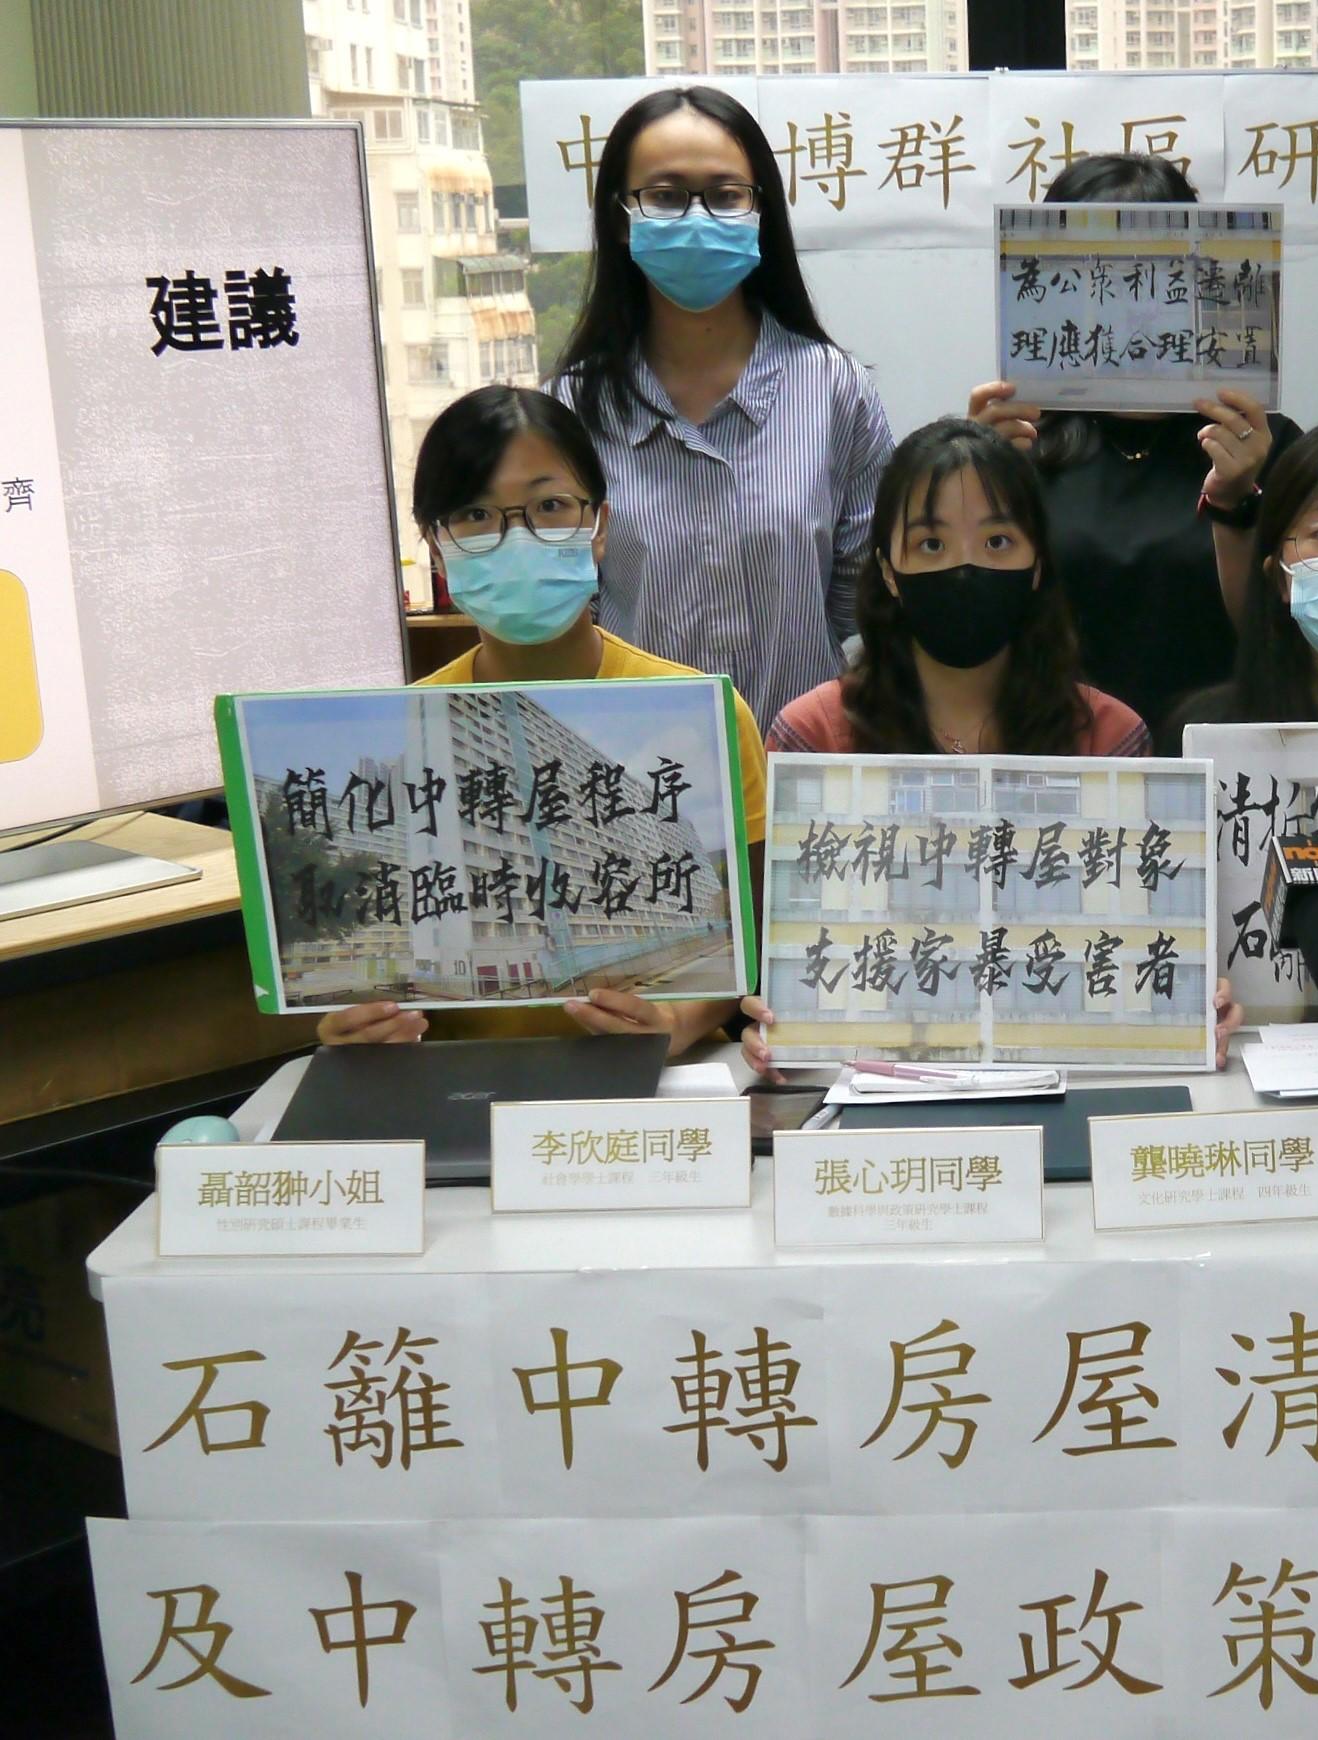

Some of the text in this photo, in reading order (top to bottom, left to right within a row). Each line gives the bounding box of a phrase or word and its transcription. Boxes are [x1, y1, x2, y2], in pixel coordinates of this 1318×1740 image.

[144, 266, 301, 357] 建議
[1011, 319, 1262, 371] 理應獲合理安置
[1, 477, 35, 513] 齊
[281, 756, 694, 841] 簡化中轉屋程序
[797, 818, 1186, 891] 檢視中轉屋對象
[798, 927, 1180, 1000] 支援家暴受害者
[532, 1128, 713, 1165] 李欣庭同學
[1130, 1136, 1315, 1181] 龔曉琳同學
[198, 1169, 385, 1208] 聶韶翀小姐
[815, 1155, 1003, 1195] 張心玥同學
